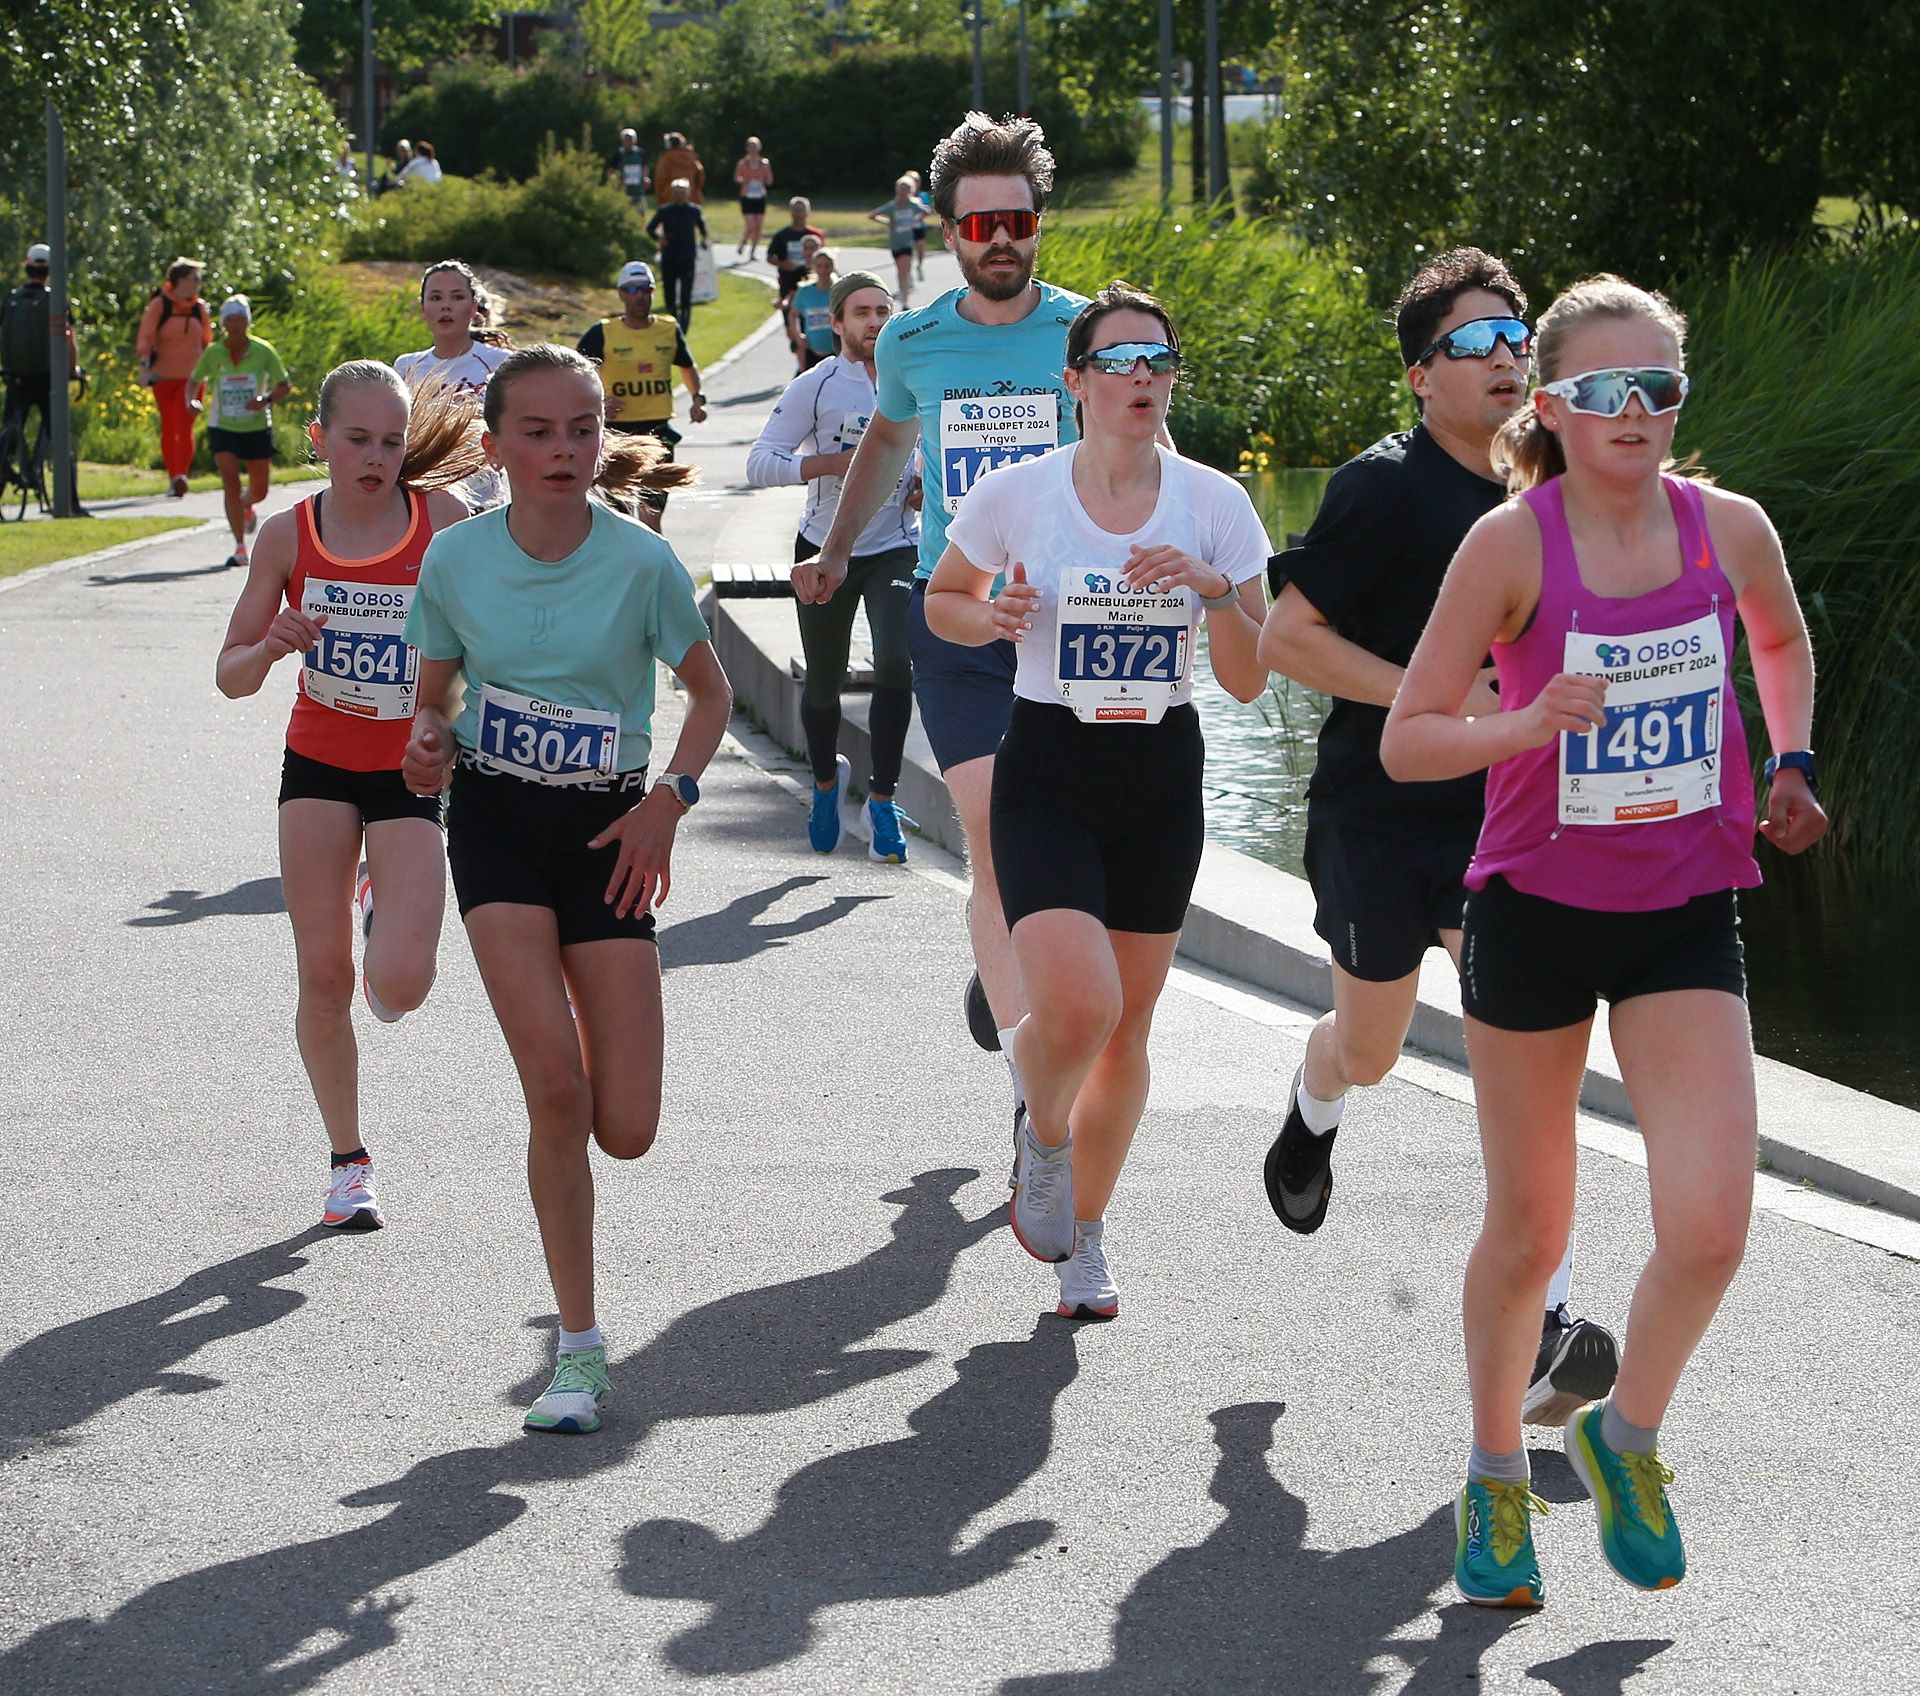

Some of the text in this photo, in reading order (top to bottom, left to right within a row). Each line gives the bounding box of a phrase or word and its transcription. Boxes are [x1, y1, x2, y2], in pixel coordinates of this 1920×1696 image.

[944, 388, 981, 400] BMW
[988, 405, 1036, 419] OBOS
[947, 420, 1050, 432] FORNEBULØPET 2024
[981, 434, 1017, 446] Yngve
[952, 453, 1039, 494] 14
[353, 593, 404, 607] OBOS
[1067, 596, 1184, 608] FORNEBULØPET 2024
[309, 603, 389, 619] FORNEBULØPET
[1108, 611, 1144, 622] Marie
[1068, 634, 1170, 678] 1372
[1638, 635, 1701, 663] OBOS
[313, 637, 399, 681] 1564
[1689, 654, 1717, 671] 2024
[530, 700, 574, 718] Celine
[490, 718, 592, 773] 1304
[1577, 705, 1693, 770] 1491
[1566, 804, 1589, 814] Fuel
[1616, 802, 1675, 815] ANTONSPORT
[1348, 922, 1360, 967] SALOMON
[1467, 1499, 1481, 1561] HOKA
